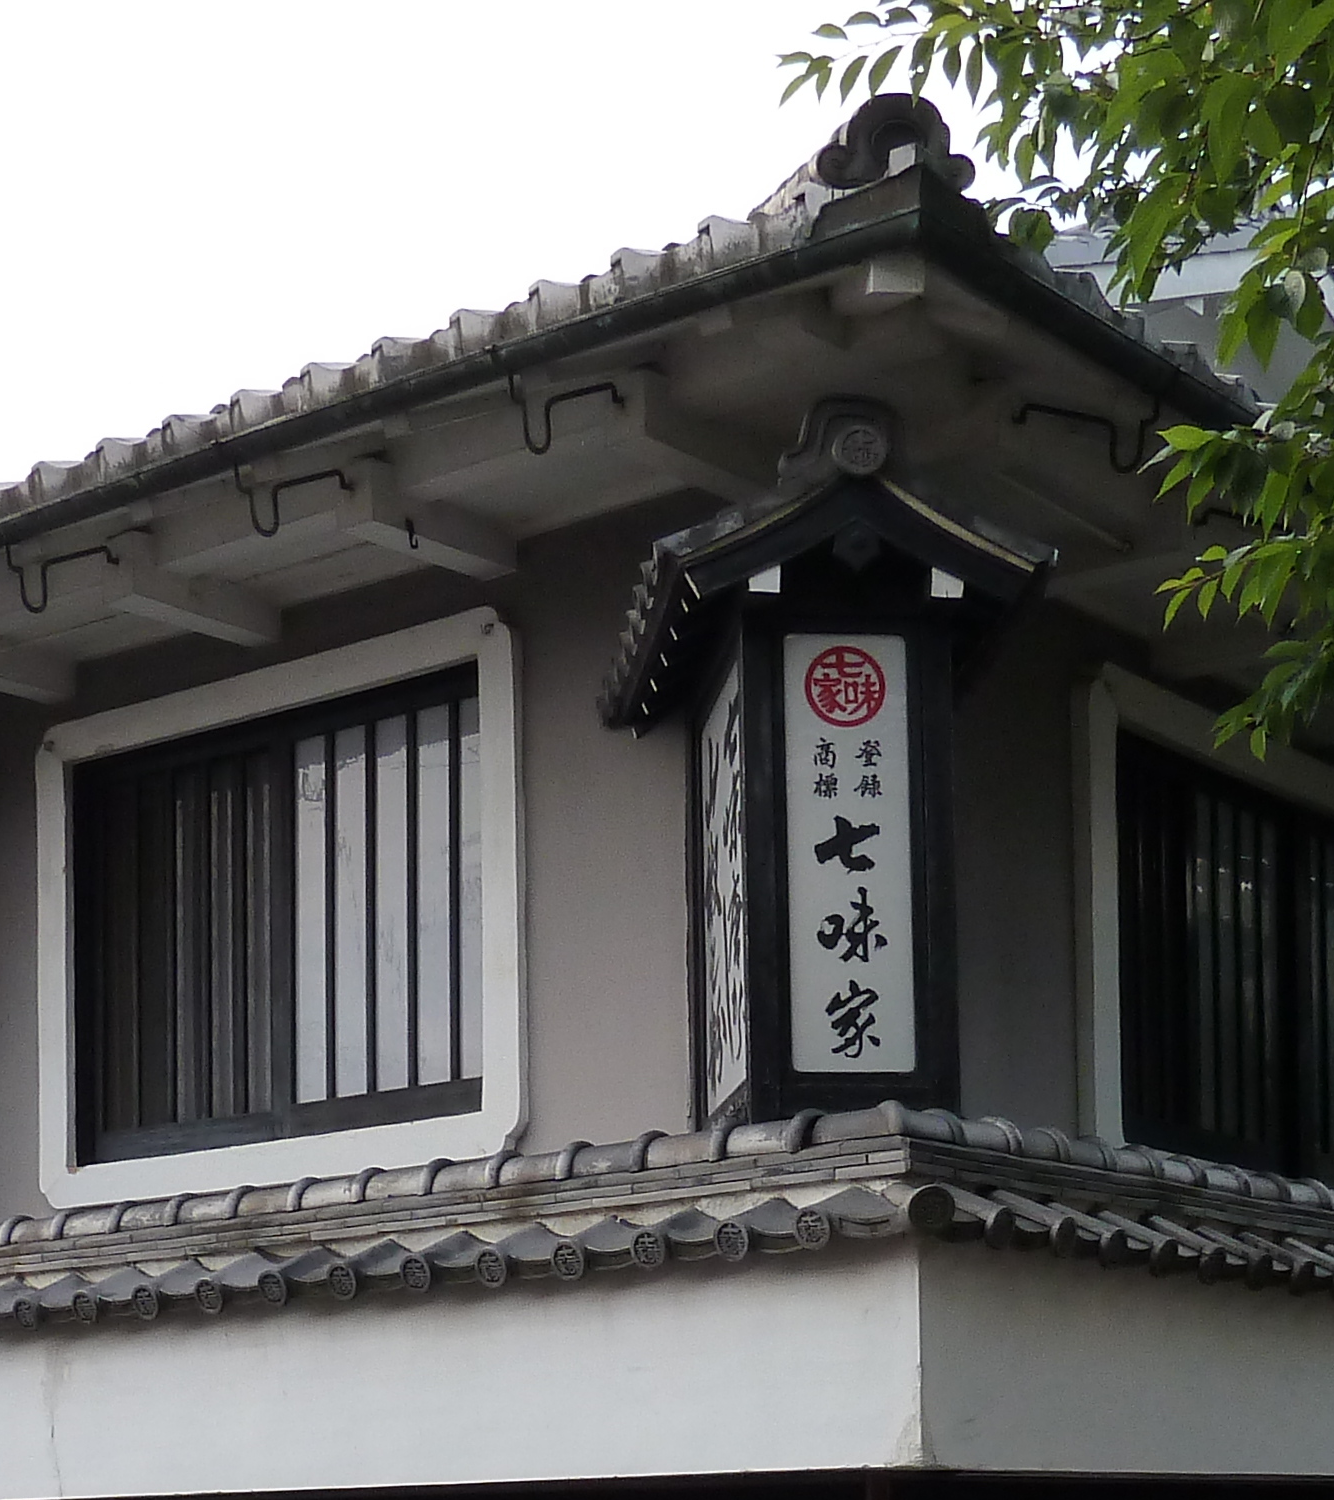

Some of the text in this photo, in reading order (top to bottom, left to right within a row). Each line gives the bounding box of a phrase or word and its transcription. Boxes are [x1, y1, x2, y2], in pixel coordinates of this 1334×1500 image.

[813, 737, 838, 799] 商標
[853, 739, 883, 798] 登録
[813, 815, 889, 1060] 七味家
